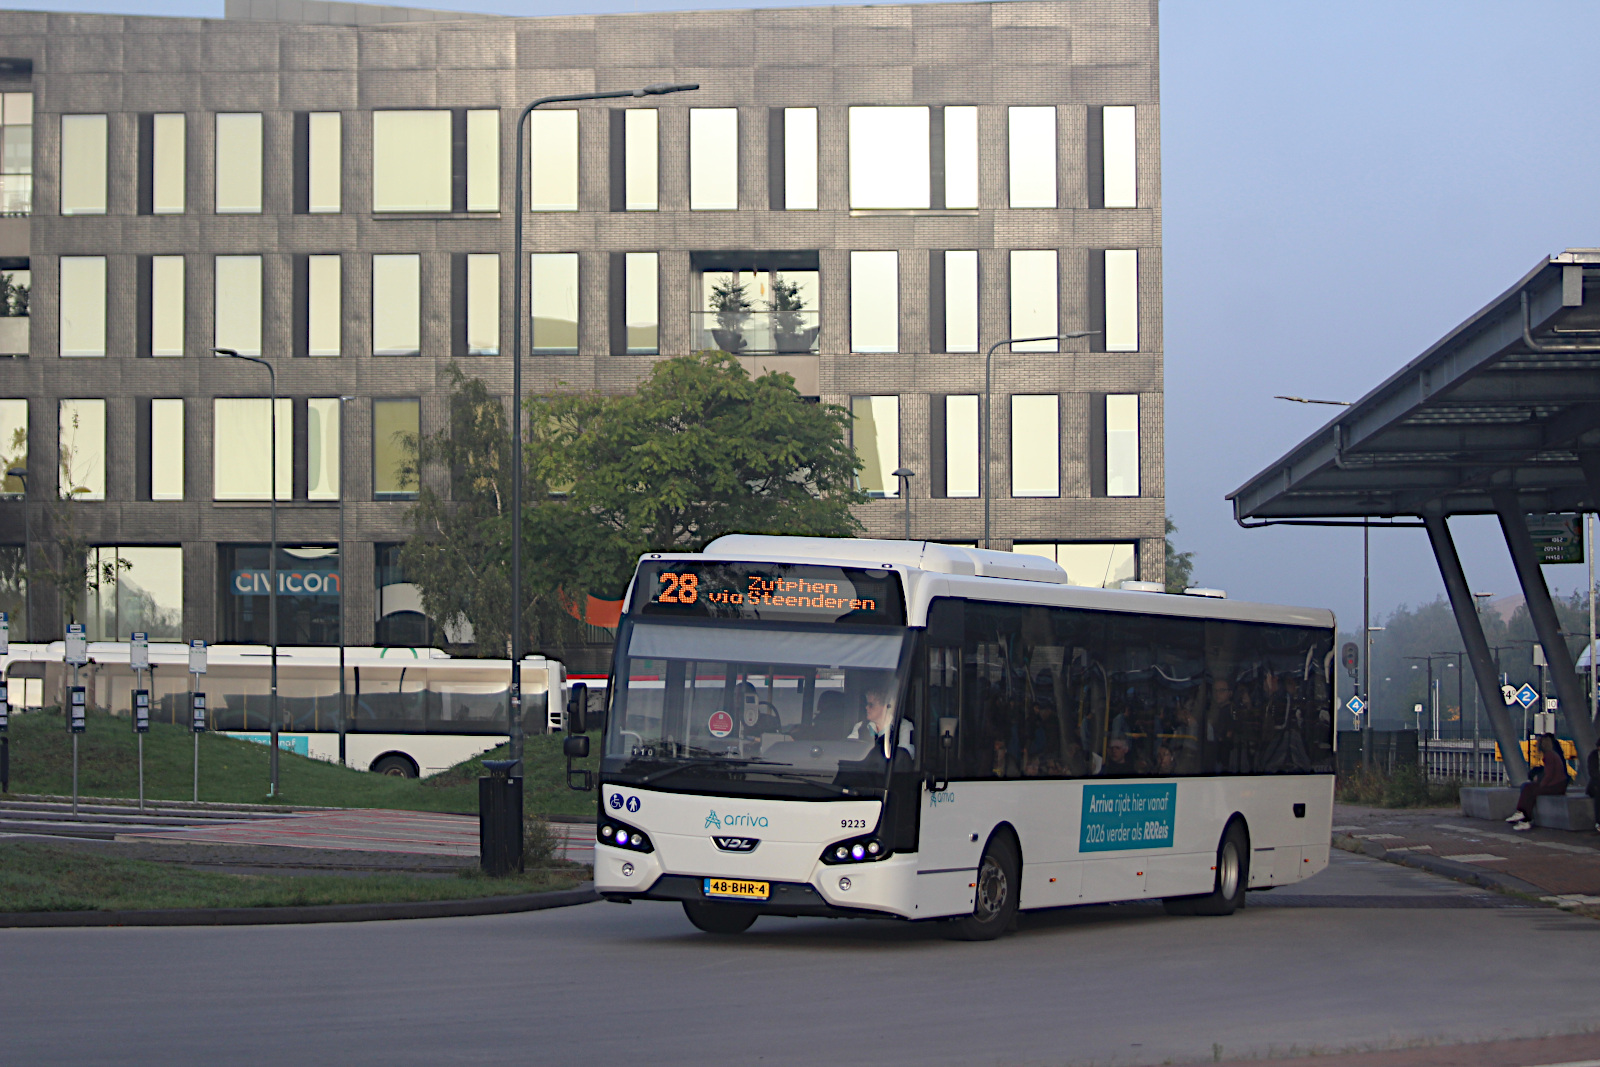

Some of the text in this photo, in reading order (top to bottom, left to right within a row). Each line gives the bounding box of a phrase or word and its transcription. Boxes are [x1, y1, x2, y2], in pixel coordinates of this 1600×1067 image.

[658, 572, 698, 604] 28
[748, 576, 839, 594] Zutphen
[709, 590, 876, 611] via Steenderen
[1522, 691, 1531, 701] 2
[1352, 701, 1360, 709] 4
[1089, 791, 1169, 817] Arriva rijdt hier vanaf
[723, 813, 769, 828] arriva
[840, 819, 866, 829] 9223
[1085, 819, 1170, 843] 2026 verder als RRReis
[718, 838, 752, 849] VDL
[711, 881, 766, 895] 48-BHR-4
